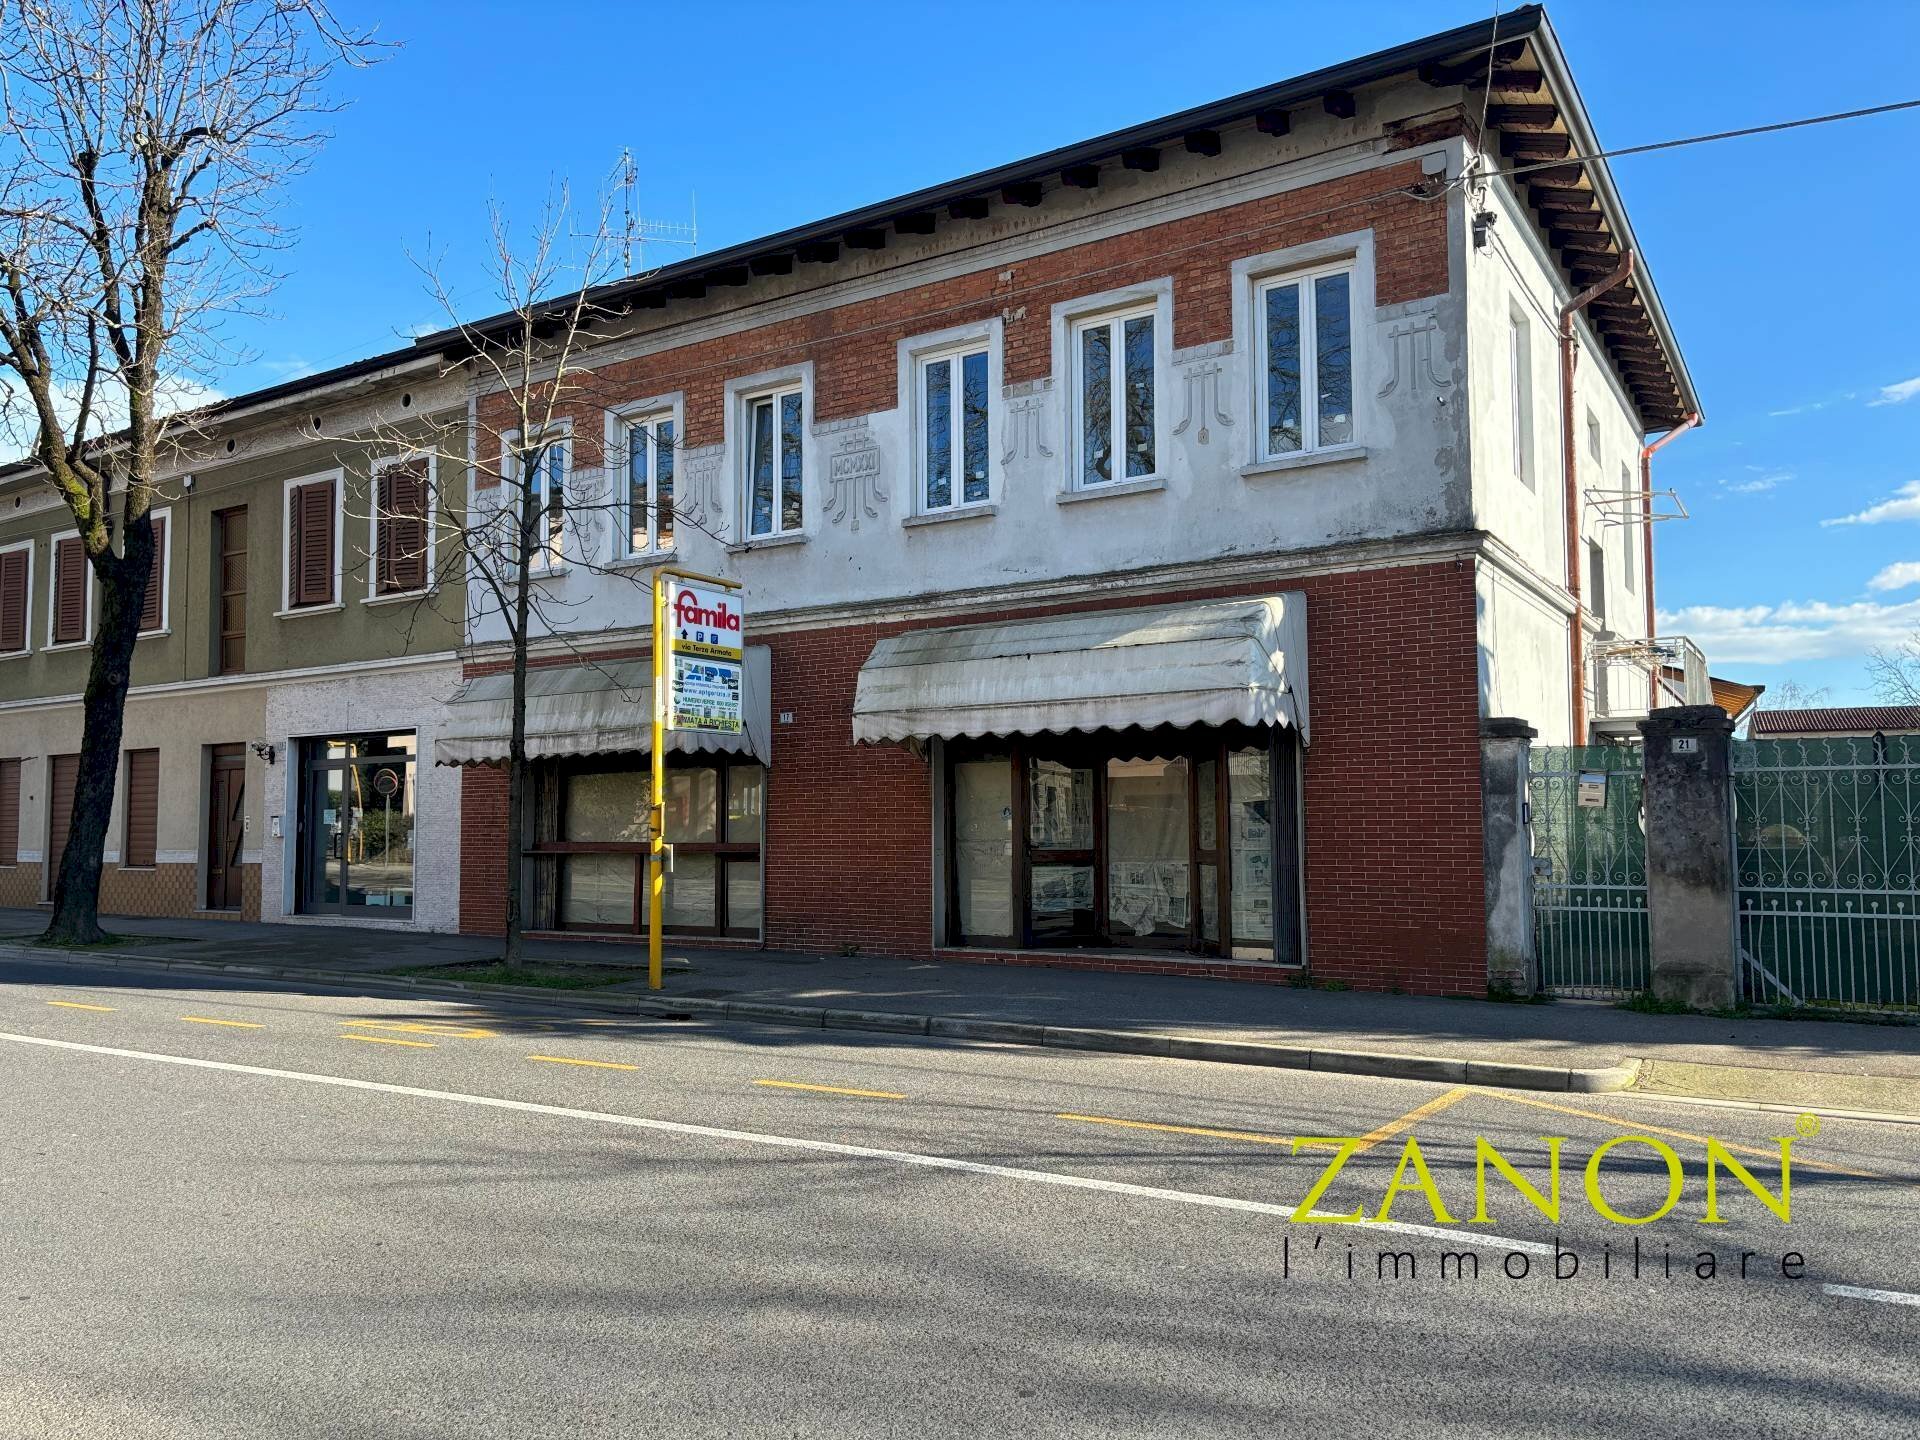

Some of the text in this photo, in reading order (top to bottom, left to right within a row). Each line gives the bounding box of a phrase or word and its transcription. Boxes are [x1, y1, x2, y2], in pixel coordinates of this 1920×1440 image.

[833, 452, 876, 477] MCMXXI
[674, 590, 740, 632] famila
[681, 643, 691, 651] via
[783, 713, 790, 721] 17
[1678, 739, 1689, 749] 21
